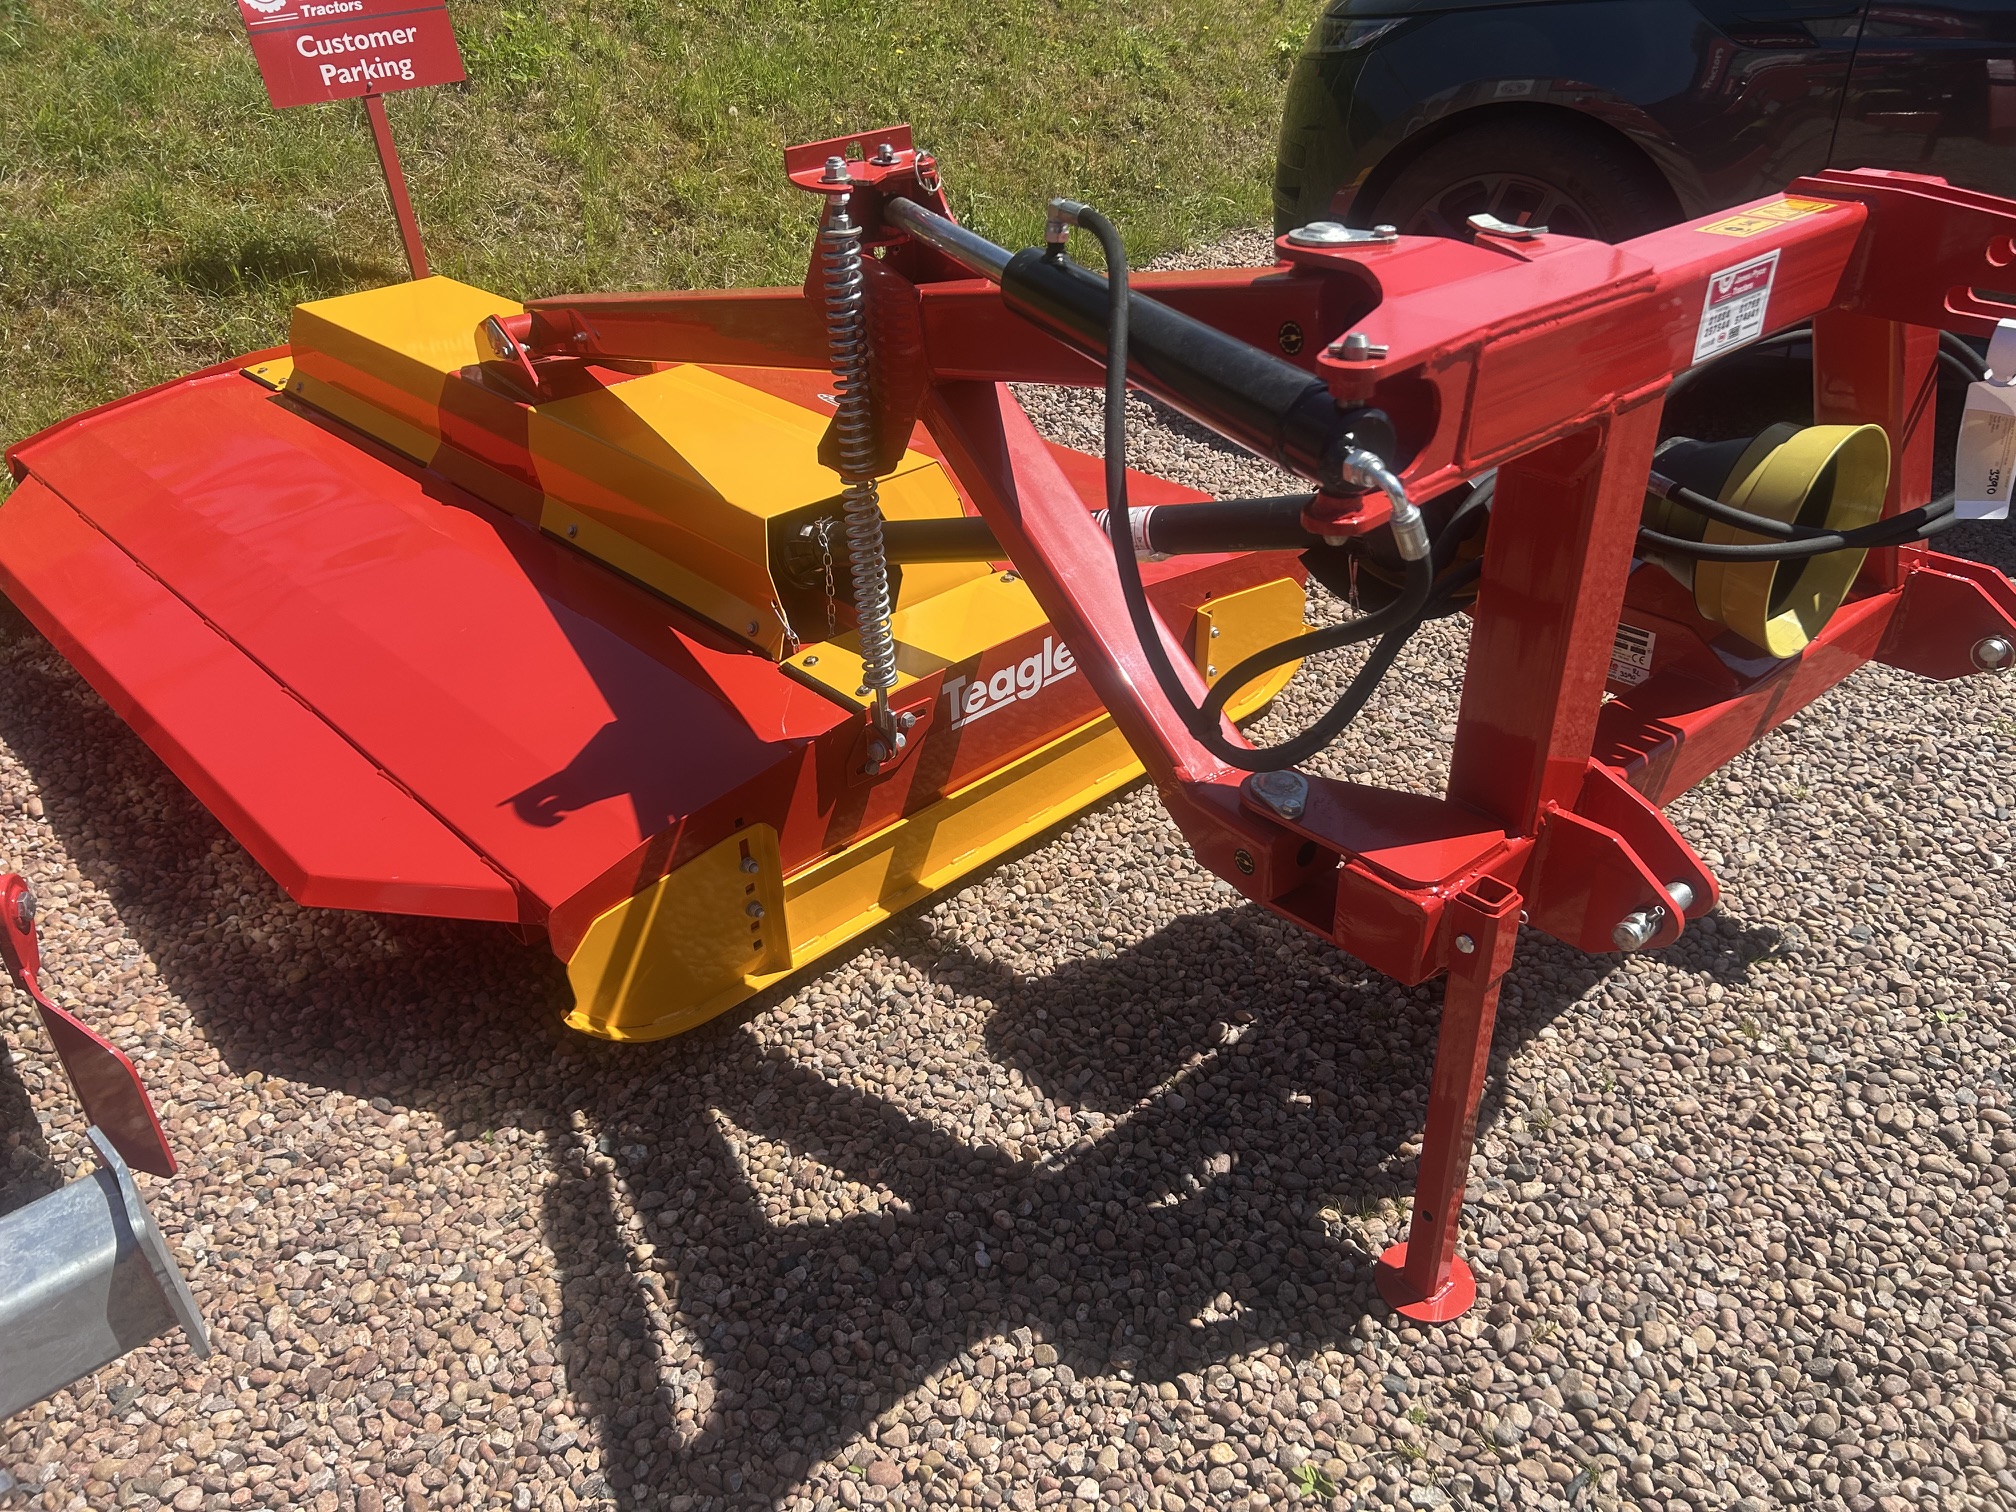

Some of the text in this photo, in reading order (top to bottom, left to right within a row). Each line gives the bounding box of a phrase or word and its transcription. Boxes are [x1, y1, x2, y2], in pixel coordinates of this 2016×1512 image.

[300, 0, 363, 17] Tractors
[296, 27, 417, 58] Customer
[319, 57, 415, 86] Parking
[1986, 469, 2000, 495] 3390
[942, 635, 1075, 721] Teagle
